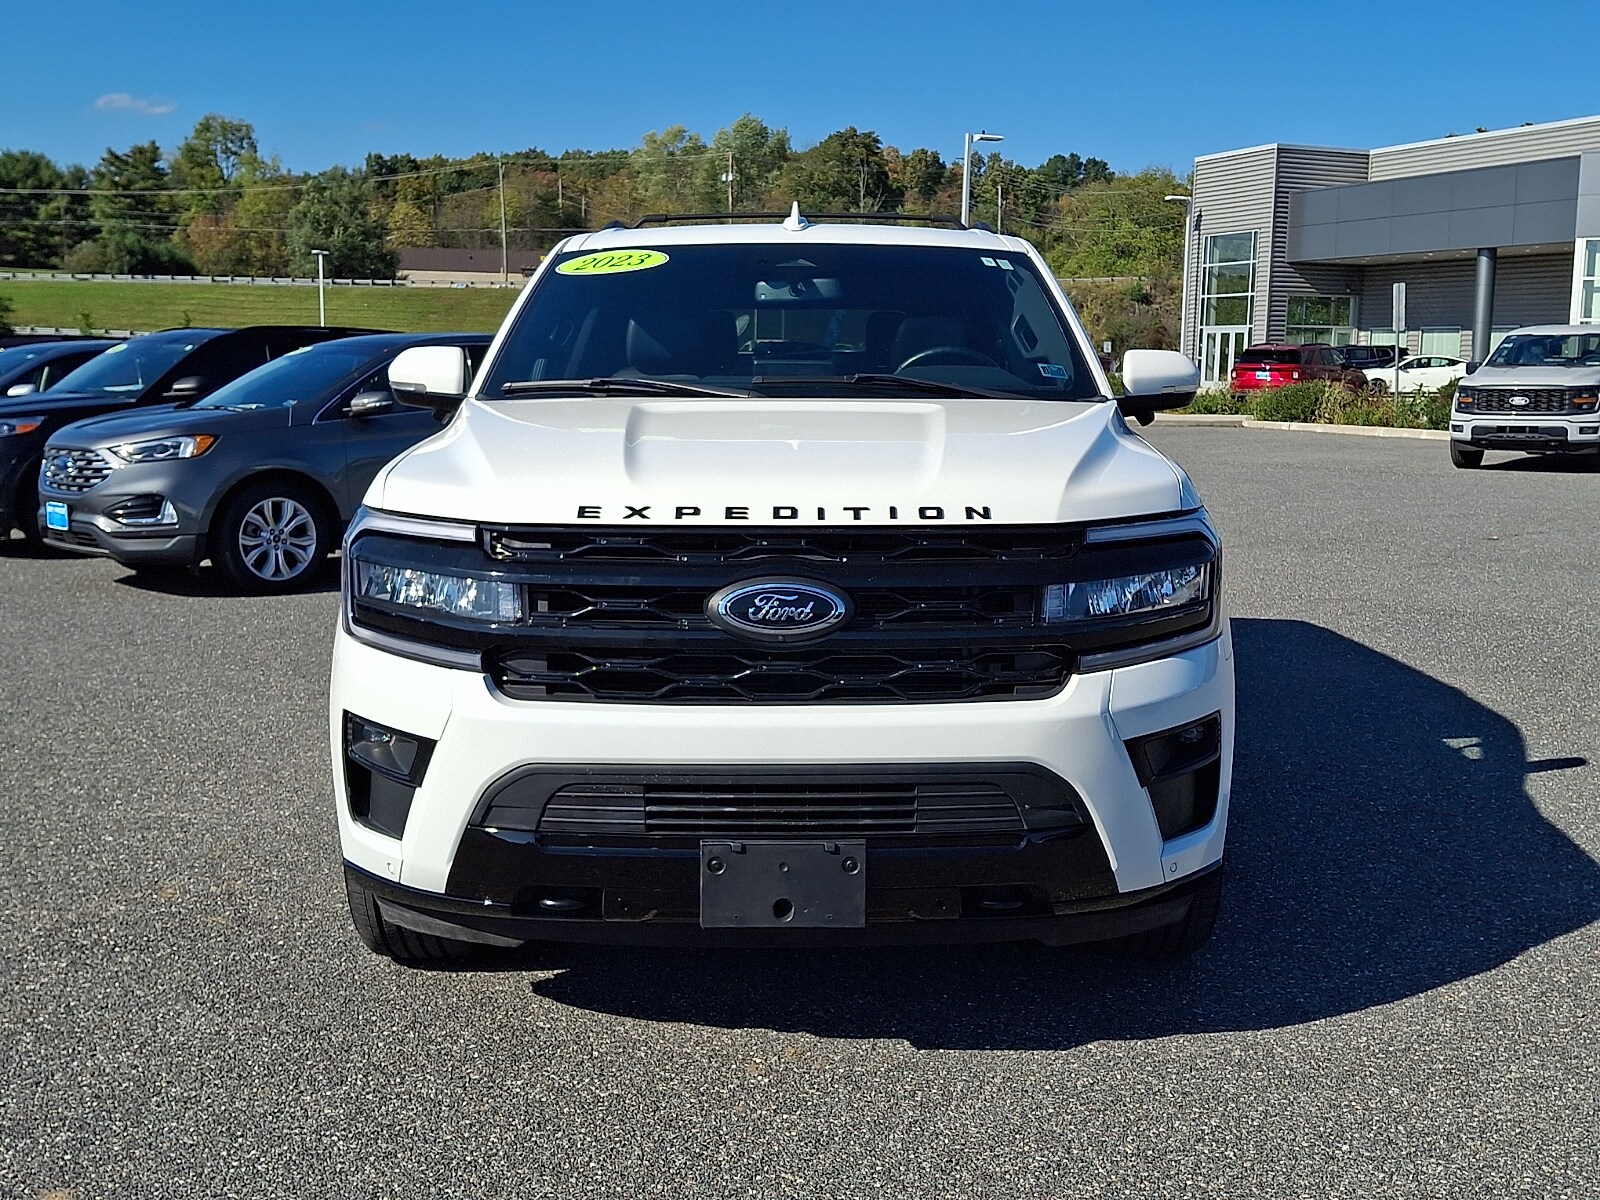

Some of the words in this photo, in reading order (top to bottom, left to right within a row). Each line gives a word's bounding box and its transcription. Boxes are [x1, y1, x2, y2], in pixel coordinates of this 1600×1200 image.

[573, 253, 652, 271] 2023
[576, 505, 992, 520] EXPEDITION
[748, 593, 815, 621] Ford
